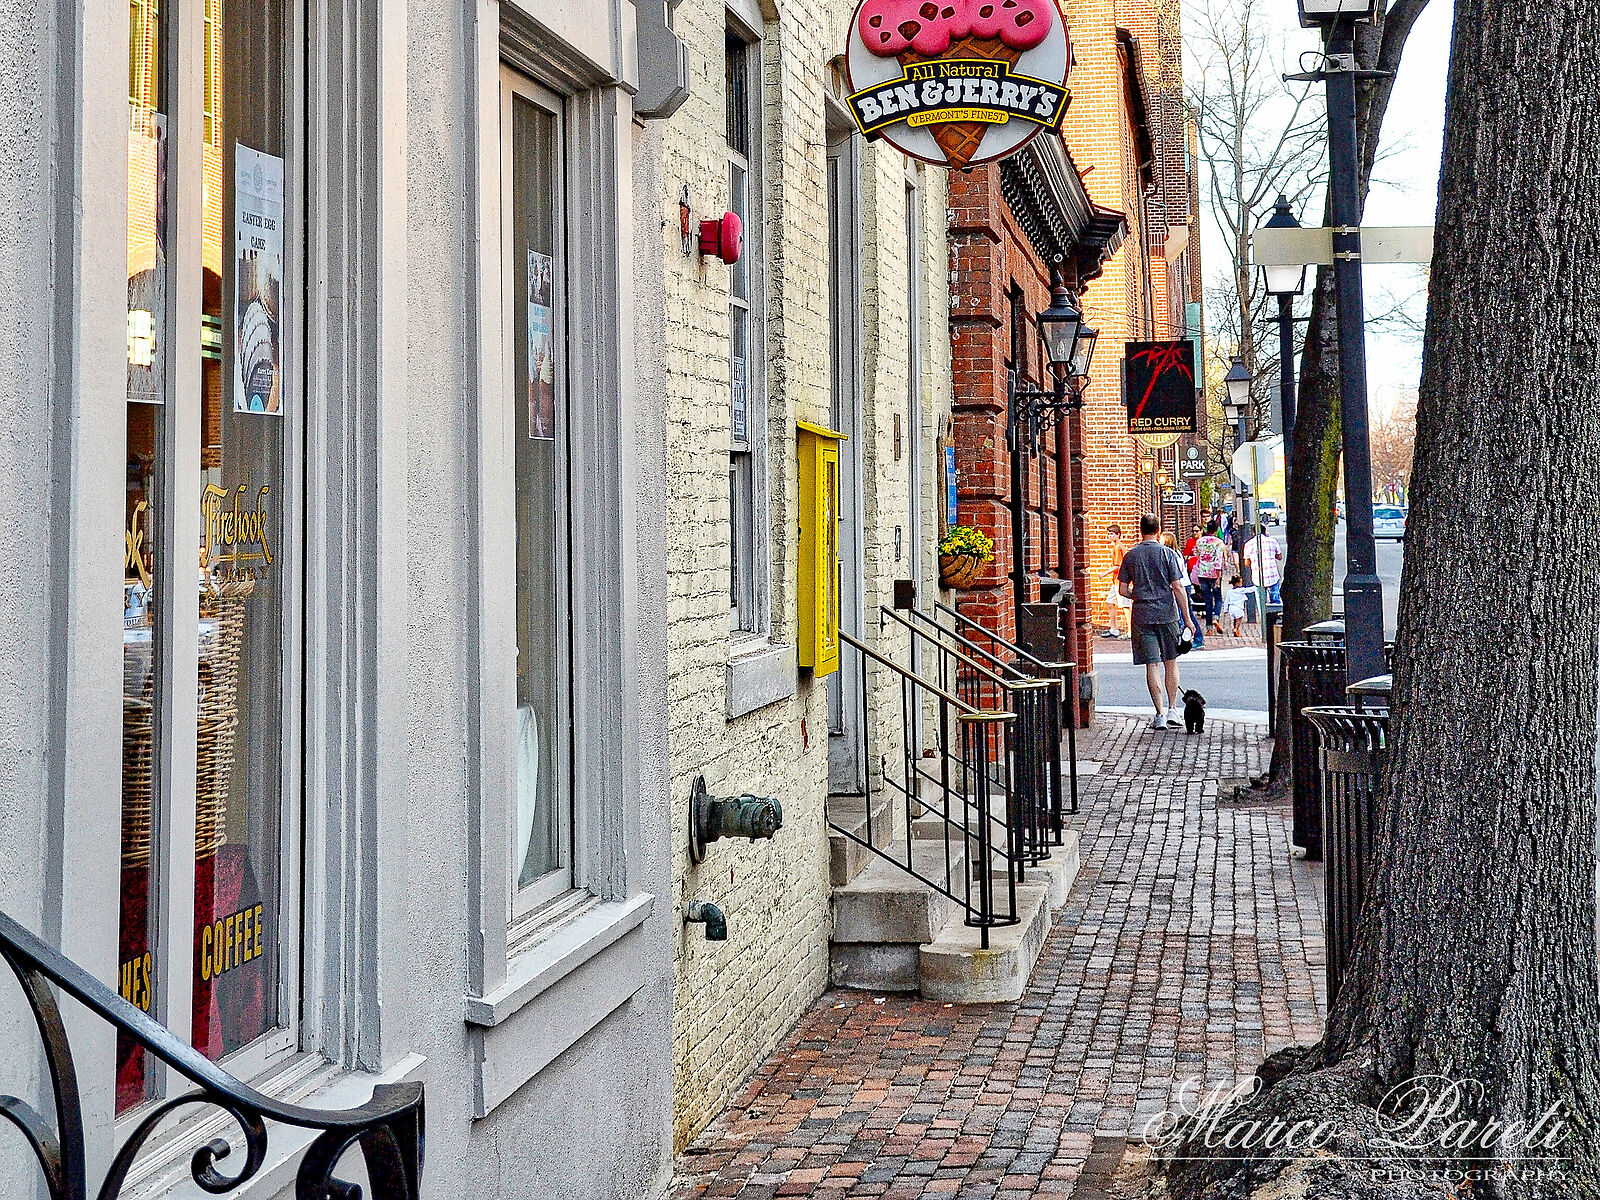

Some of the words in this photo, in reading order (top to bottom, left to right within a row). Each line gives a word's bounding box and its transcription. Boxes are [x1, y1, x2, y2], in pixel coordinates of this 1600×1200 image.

[912, 65, 935, 81] All
[939, 63, 1000, 78] Natural
[910, 109, 969, 124] VERMONT'S
[970, 110, 1007, 122] FINEST
[242, 211, 263, 228] EASTER
[264, 217, 276, 231] EGG
[1130, 418, 1152, 427] RED
[1154, 416, 1191, 426] CURRY
[1180, 460, 1205, 470] PARK
[201, 483, 273, 568] Firehook
[201, 904, 263, 981] COFFEE
